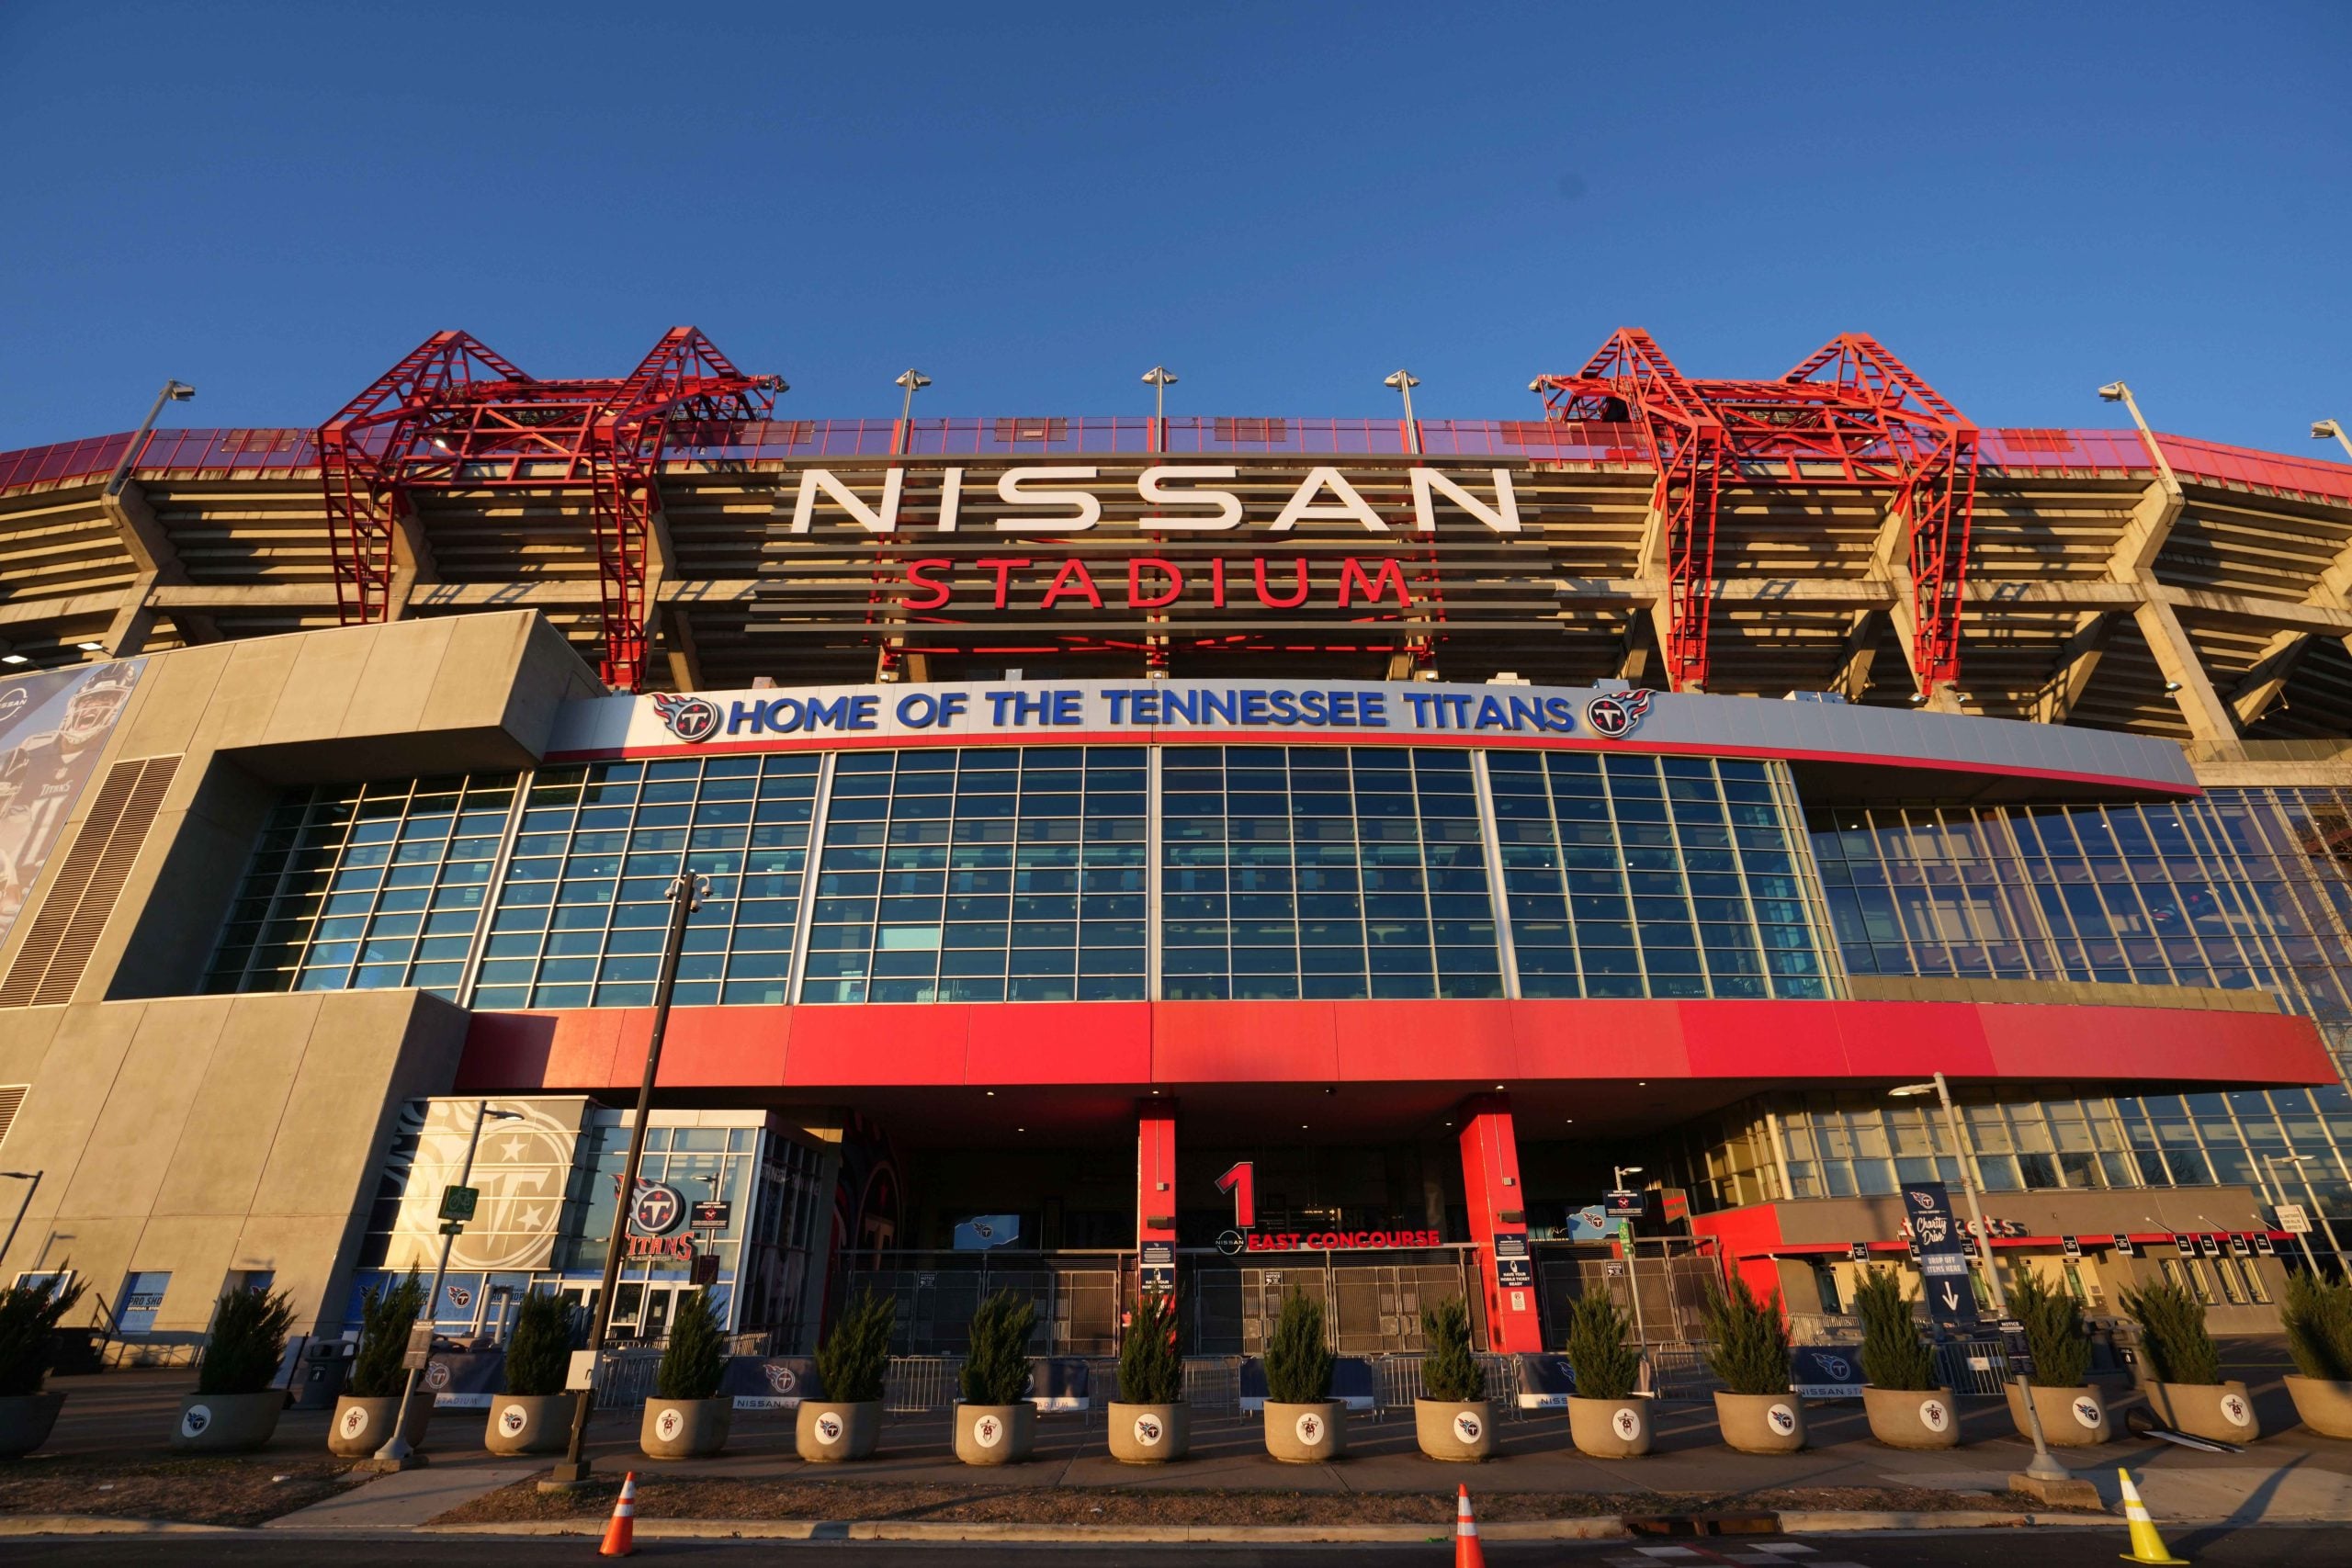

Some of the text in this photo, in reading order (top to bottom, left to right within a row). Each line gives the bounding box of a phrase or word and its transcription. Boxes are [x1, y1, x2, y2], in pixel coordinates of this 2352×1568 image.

[790, 466, 1522, 533] NISSAN
[901, 557, 1414, 611] STADIUM
[726, 689, 1575, 735] HOME OF THE TENNESSEE TITANS
[1215, 1162, 1256, 1228] 1
[1917, 1216, 1948, 1235] Charity
[626, 1231, 695, 1261] ITANS
[1248, 1230, 1442, 1251] EAST CONCOURSE
[1922, 1230, 1945, 1246] Drive
[1928, 1257, 1943, 1265] DROP
[129, 1296, 164, 1305] PRO SHO
[435, 1396, 479, 1405] STADIUM
[737, 1400, 781, 1408] NISSAN
